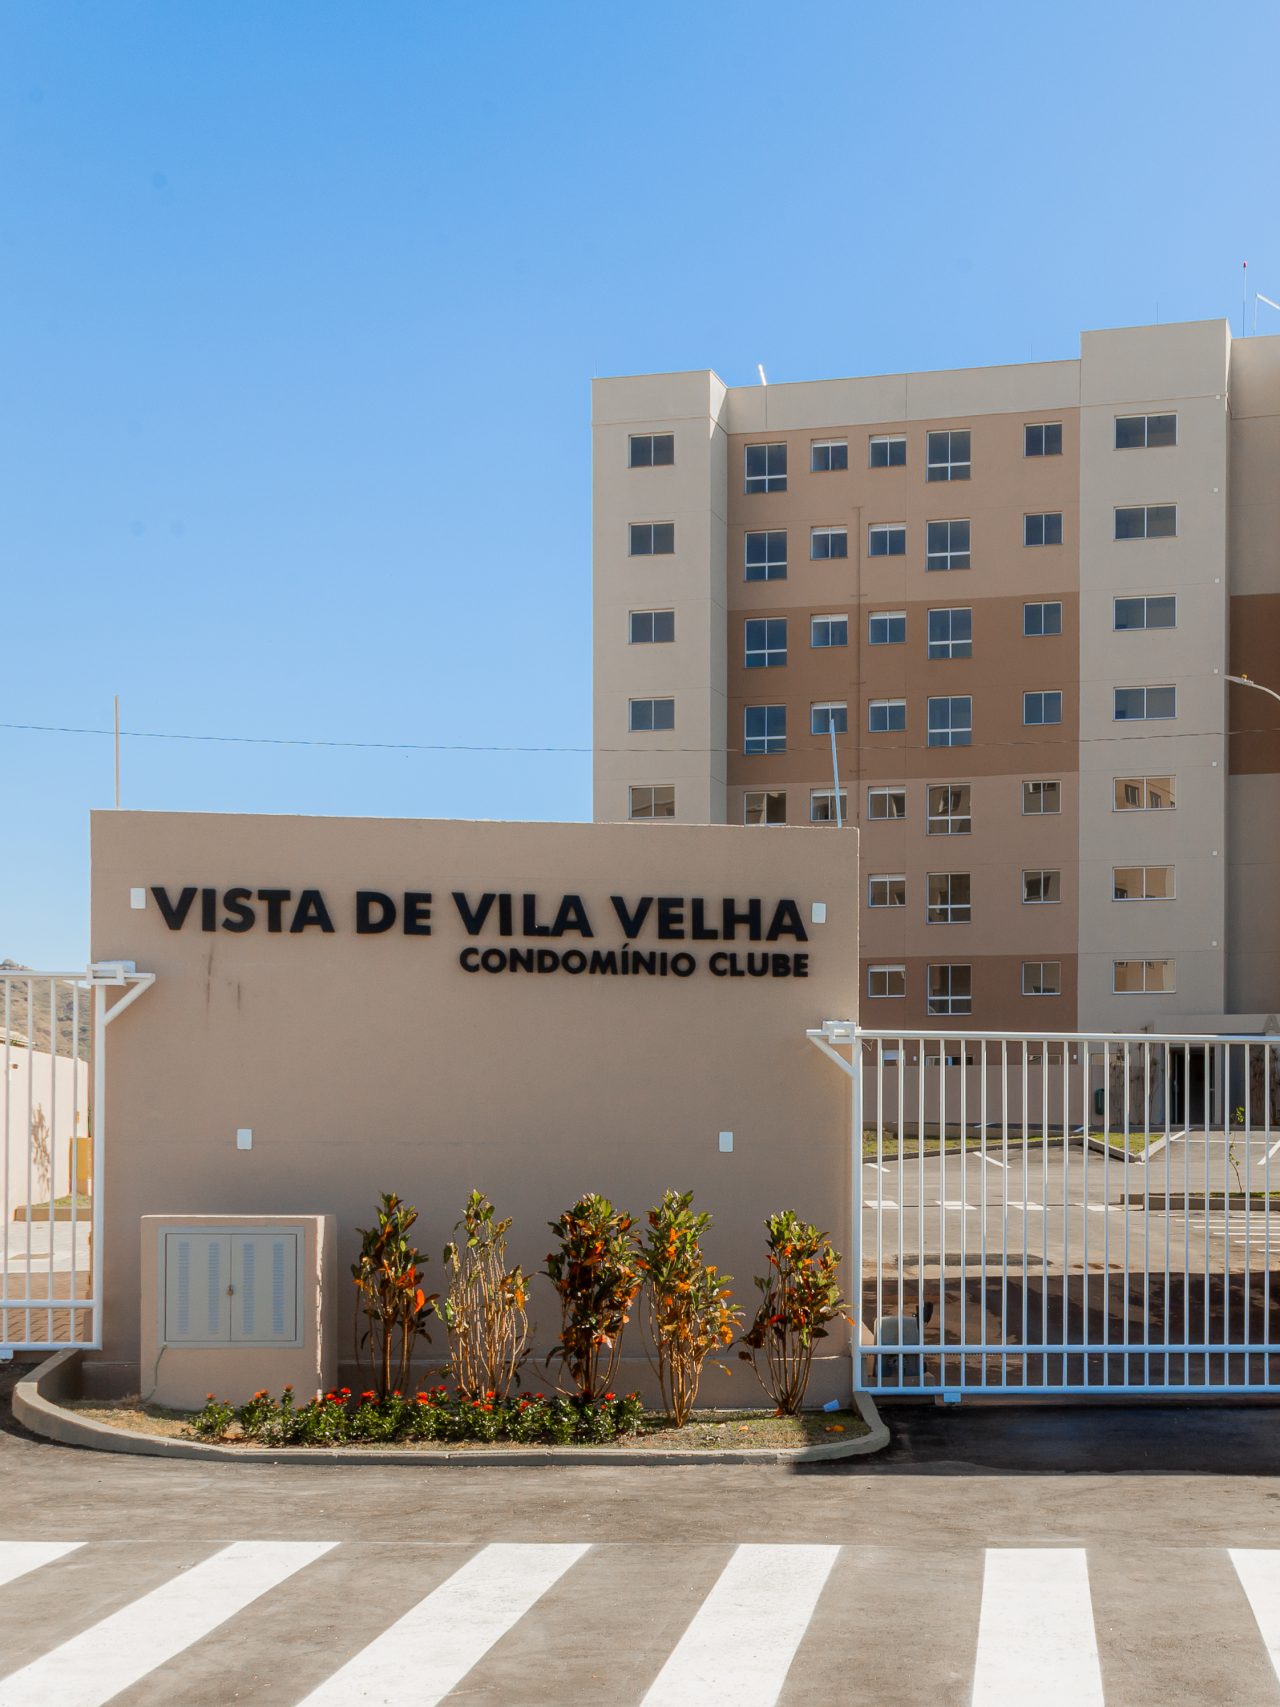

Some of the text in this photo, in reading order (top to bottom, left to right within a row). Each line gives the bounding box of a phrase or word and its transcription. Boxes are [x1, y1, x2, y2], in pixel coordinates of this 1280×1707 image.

[151, 887, 808, 942] VISTA DE VILA VELHA
[459, 943, 810, 978] CONDOMÍNIO CLUBE
[1263, 1015, 1280, 1033] A
